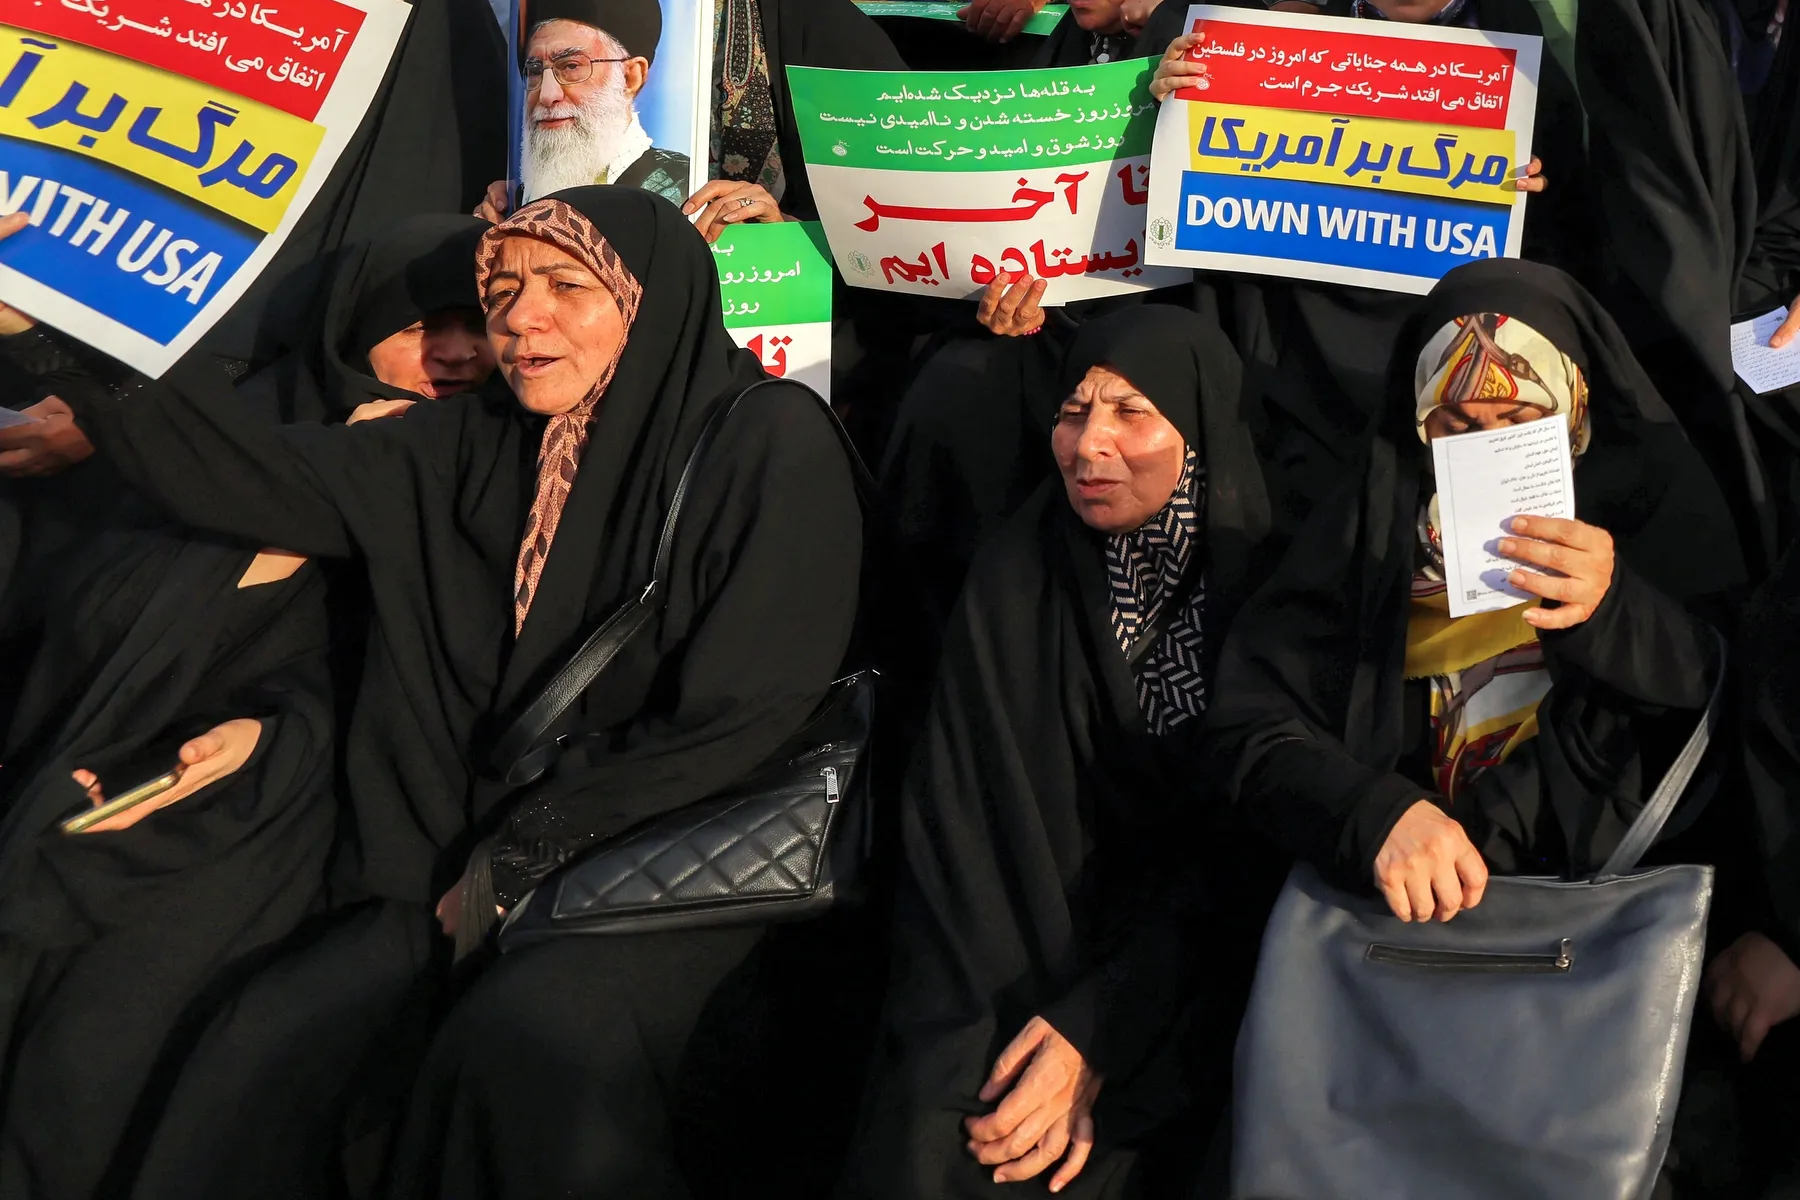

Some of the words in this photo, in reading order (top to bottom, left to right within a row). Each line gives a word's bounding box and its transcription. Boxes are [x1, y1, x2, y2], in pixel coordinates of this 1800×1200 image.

[213, 1, 247, 19] در
[249, 2, 350, 54] آمریکا
[176, 30, 229, 56] افتد
[1192, 39, 1245, 60] فلسطین
[1248, 46, 1266, 60] در
[224, 54, 264, 73] می
[1269, 50, 1306, 69] امروز
[1310, 50, 1329, 65] که
[1330, 52, 1387, 76] جنایاتی
[1390, 58, 1428, 74] همه
[266, 55, 326, 92] اتفاق
[1429, 62, 1446, 77] در
[1449, 61, 1511, 86] آمریکا
[949, 83, 1016, 104] نزدیک
[1071, 82, 1096, 96] به
[1301, 79, 1343, 99] جرم
[1410, 87, 1440, 104] افتد
[1441, 94, 1466, 112] می
[1467, 94, 1503, 111] اتفاق
[26, 80, 129, 149] بر
[819, 111, 877, 127] نیست
[879, 112, 951, 130] ناامیدی
[955, 116, 968, 130] و
[969, 110, 1010, 131] شدن
[1012, 108, 1072, 125] خسته
[1074, 108, 1108, 123] روز
[128, 100, 298, 199] مرگ
[875, 140, 913, 155] است
[915, 140, 973, 161] حرکت
[987, 139, 1028, 157] امید
[1046, 136, 1088, 157] شوق
[1087, 132, 1125, 151] روز
[1197, 116, 1350, 178] آمریکا
[1343, 140, 1394, 184] بر
[1399, 133, 1509, 191] مرگ
[853, 170, 1090, 233] آخر
[1186, 194, 1309, 236] DOWN
[1318, 205, 1417, 249] WITH
[1424, 219, 1498, 259] USA
[710, 243, 734, 256] به
[116, 219, 223, 306] USA
[746, 260, 800, 282] امروز
[879, 241, 950, 287] ایم
[970, 238, 1141, 286] یستاده
[723, 299, 760, 315] روز
